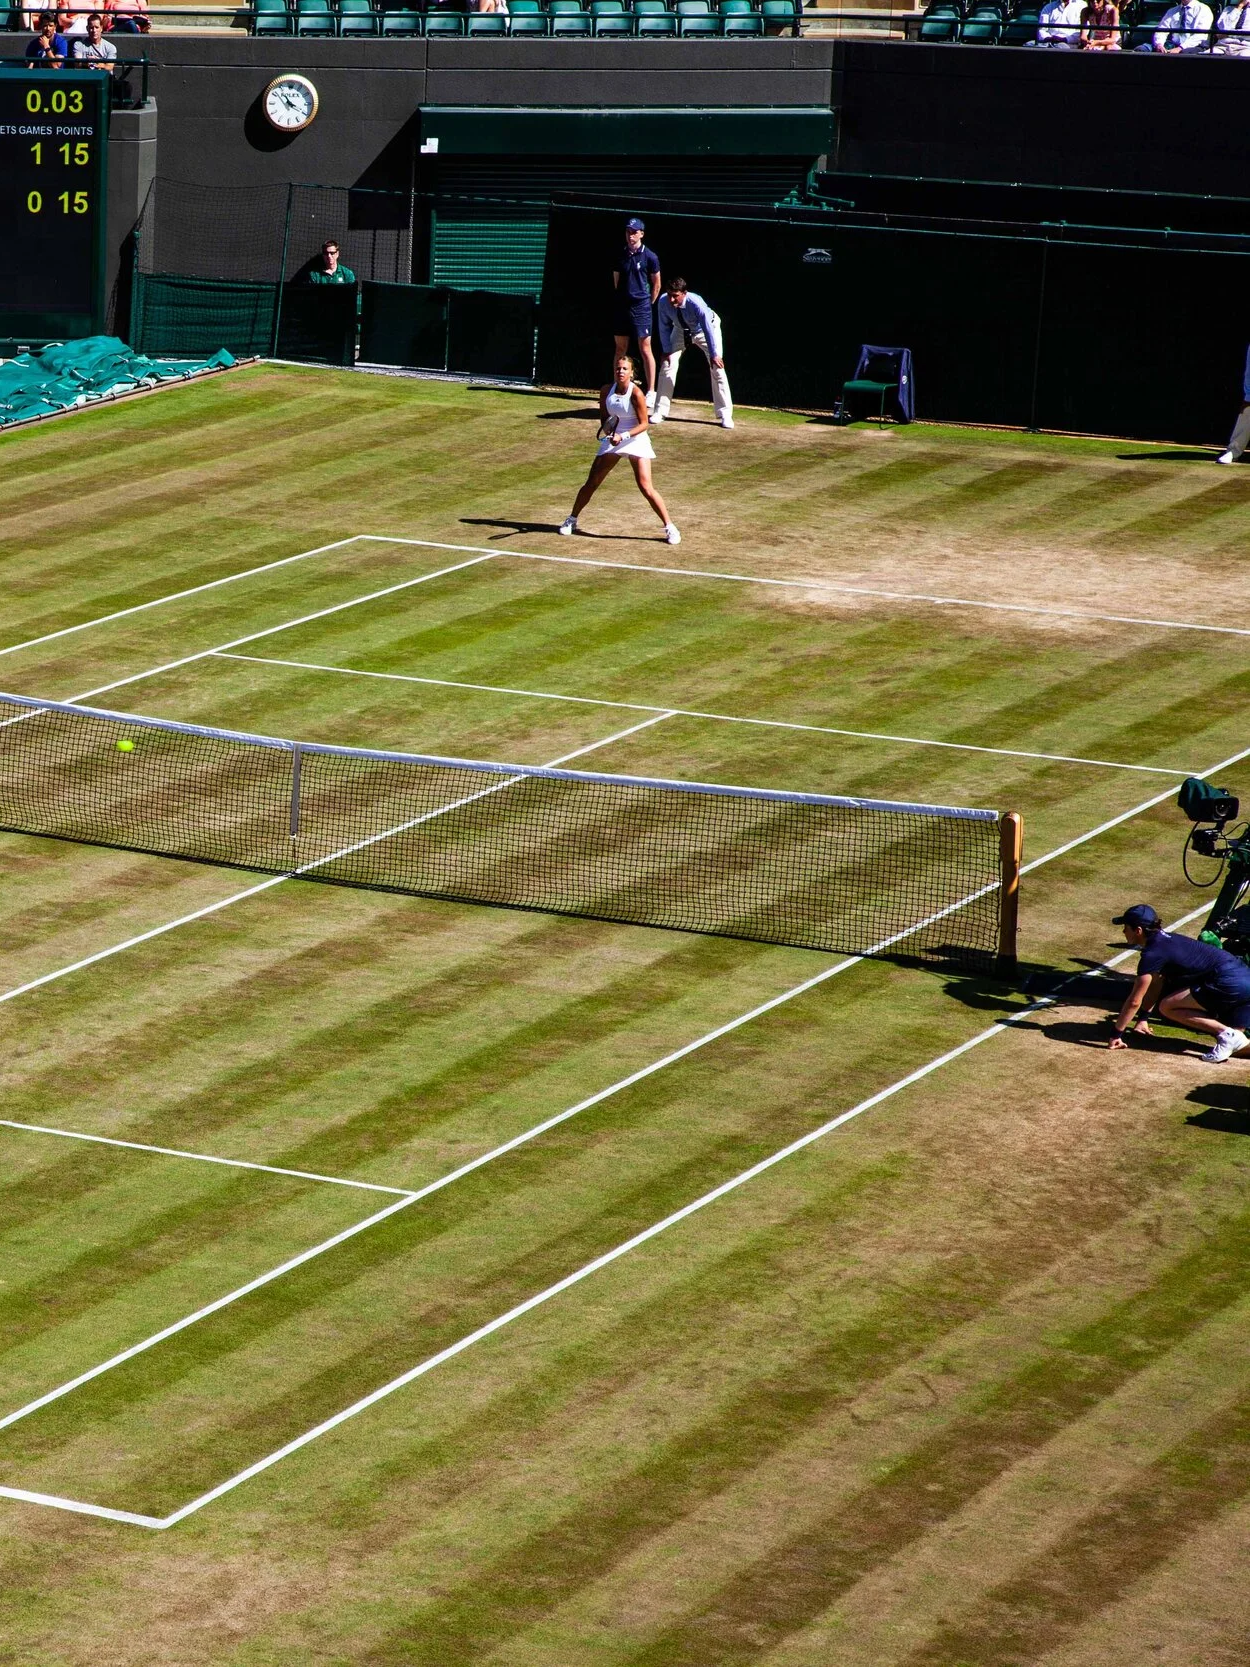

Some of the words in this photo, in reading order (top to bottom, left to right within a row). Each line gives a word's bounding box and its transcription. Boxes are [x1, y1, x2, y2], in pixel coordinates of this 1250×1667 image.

[26, 89, 84, 114] 0.03
[18, 125, 53, 136] GAMES
[56, 126, 94, 136] POINTS
[30, 142, 41, 165] 1
[58, 142, 89, 166] 15
[27, 190, 42, 214] 0
[58, 191, 89, 214] 15
